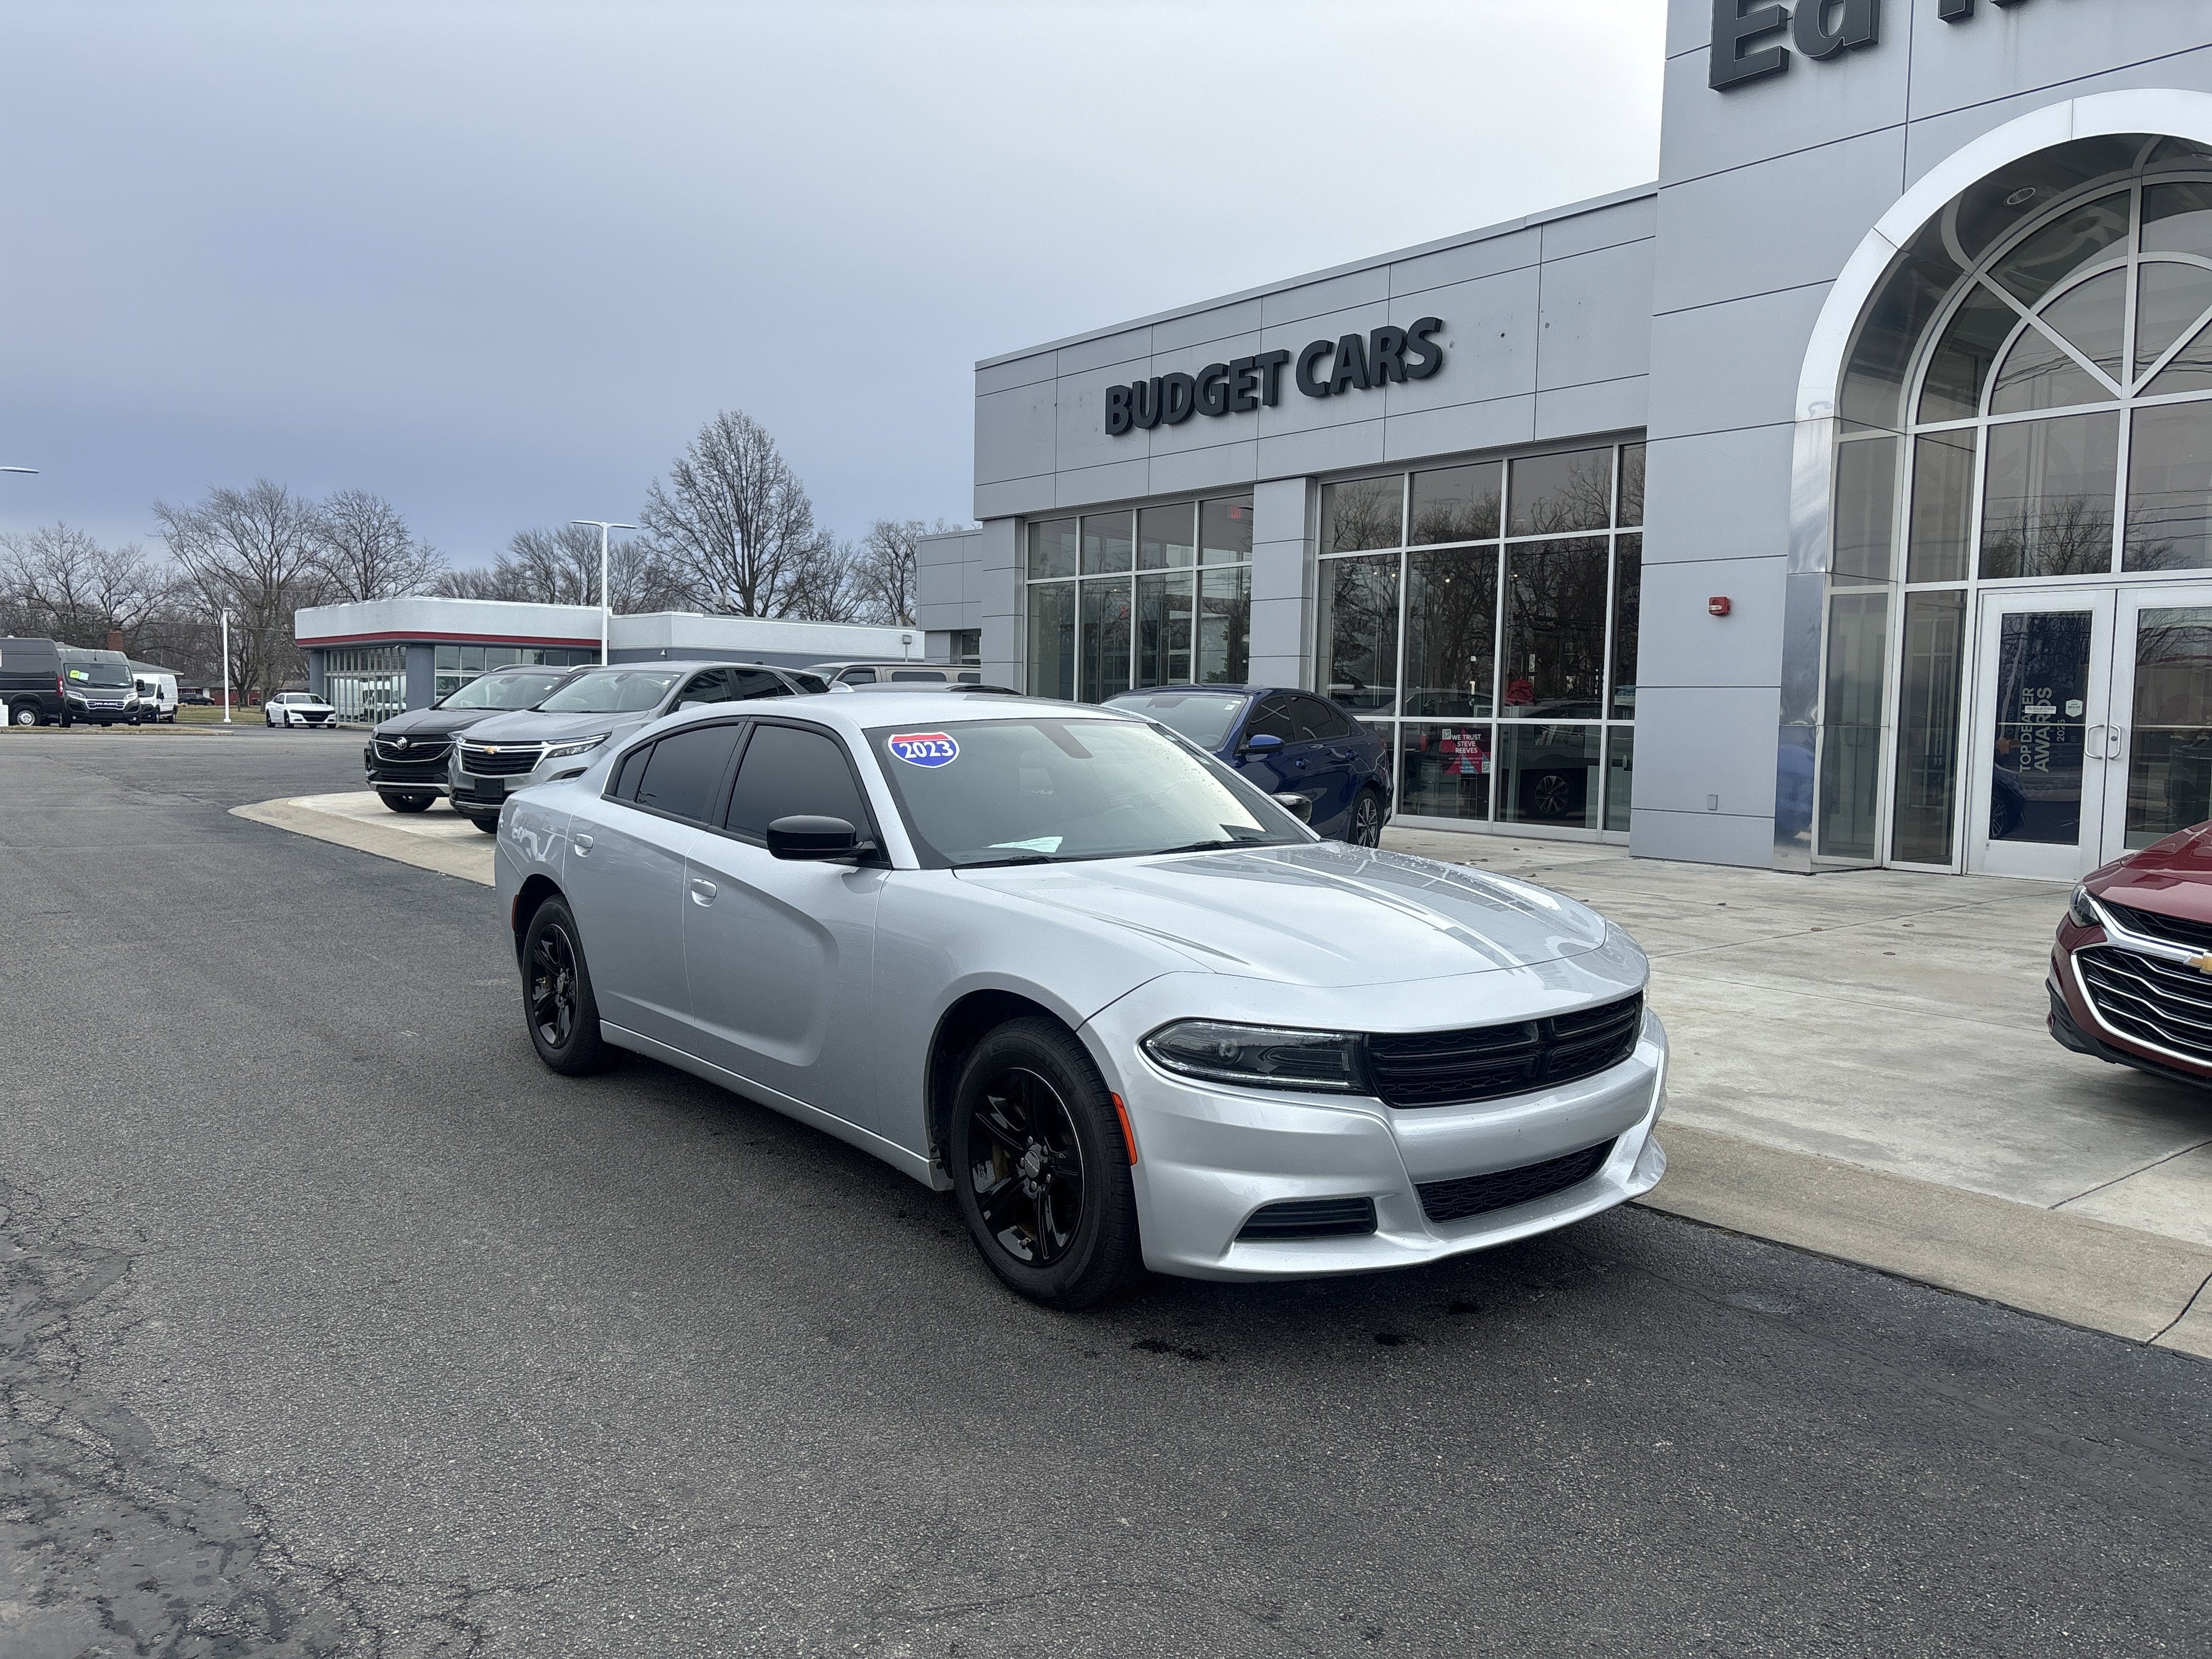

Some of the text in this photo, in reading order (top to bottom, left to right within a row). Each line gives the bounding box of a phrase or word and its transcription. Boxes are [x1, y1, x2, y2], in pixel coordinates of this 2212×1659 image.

[1105, 317, 1443, 435] BUDGET CARS
[899, 741, 953, 759] 2023
[2019, 687, 2034, 772] TOP DEAER
[2034, 687, 2052, 772] AWARDS
